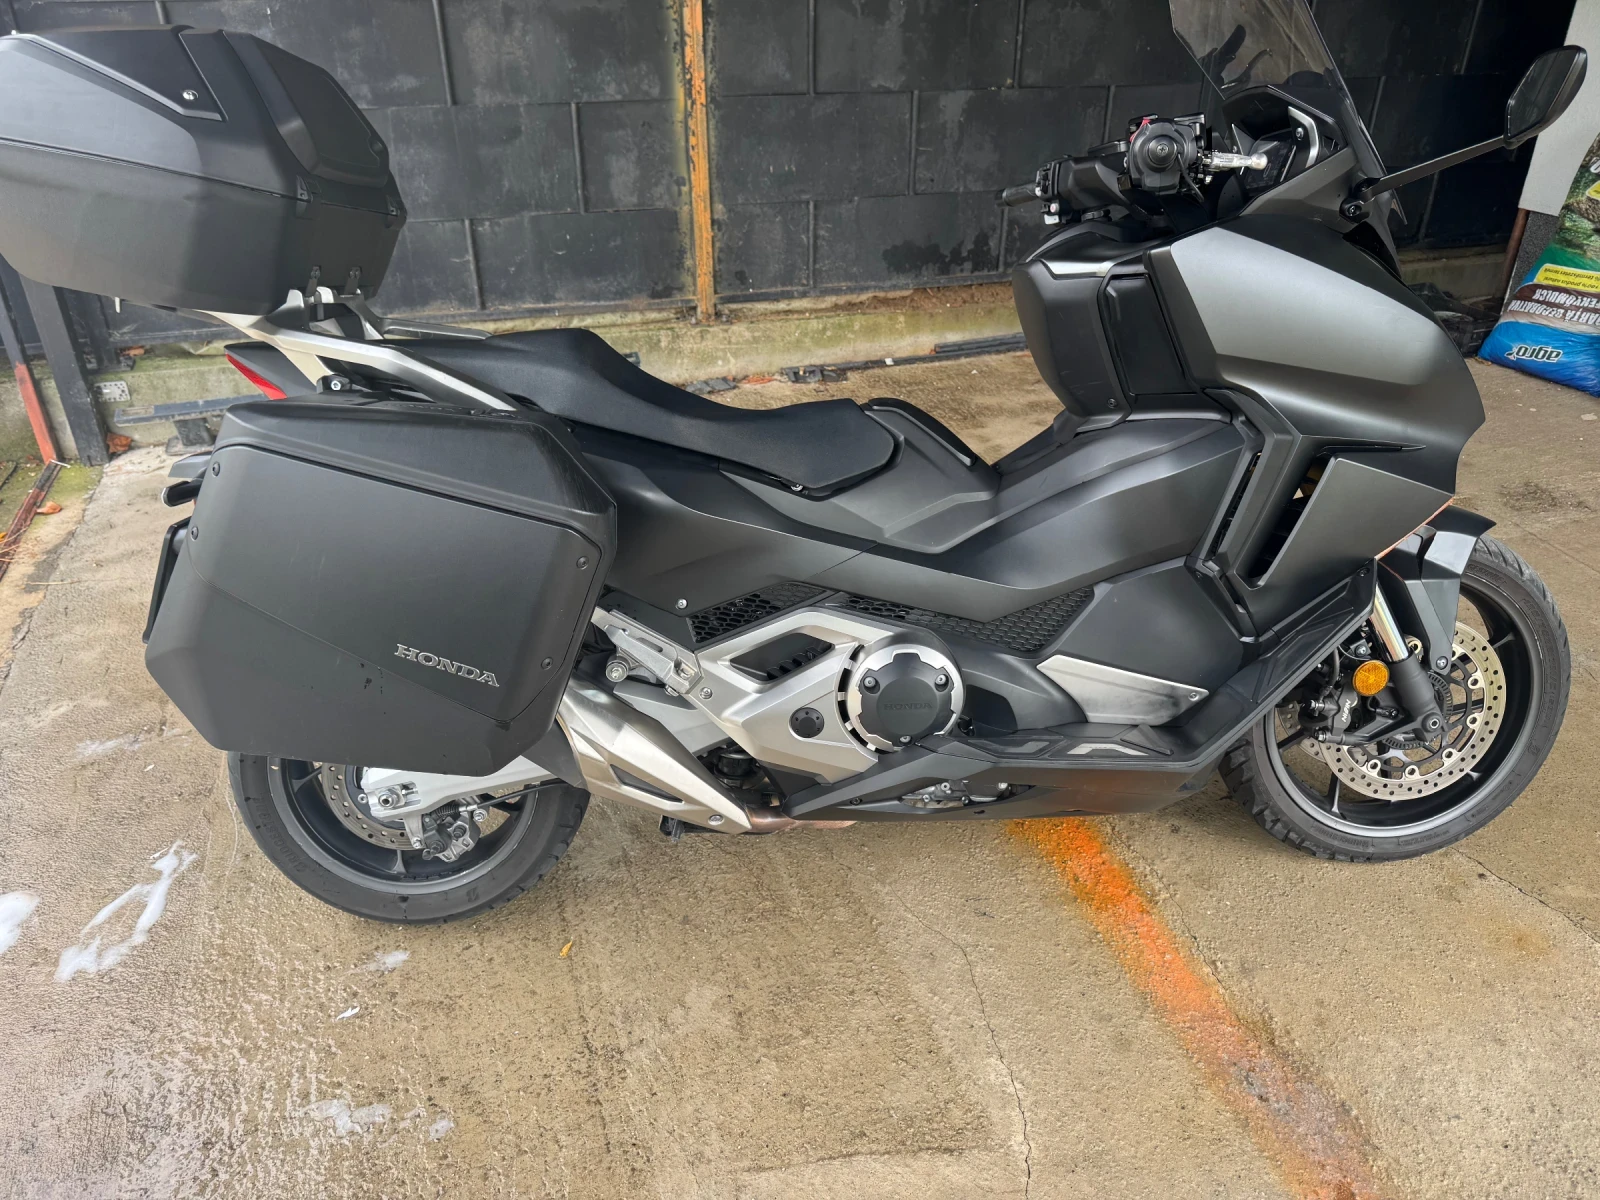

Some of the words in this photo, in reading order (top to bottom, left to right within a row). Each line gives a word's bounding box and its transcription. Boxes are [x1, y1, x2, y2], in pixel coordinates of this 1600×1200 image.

[1561, 279, 1582, 287] produs
[1514, 344, 1563, 363] agro
[393, 643, 500, 687] HONDA
[883, 702, 933, 711] HONDA
